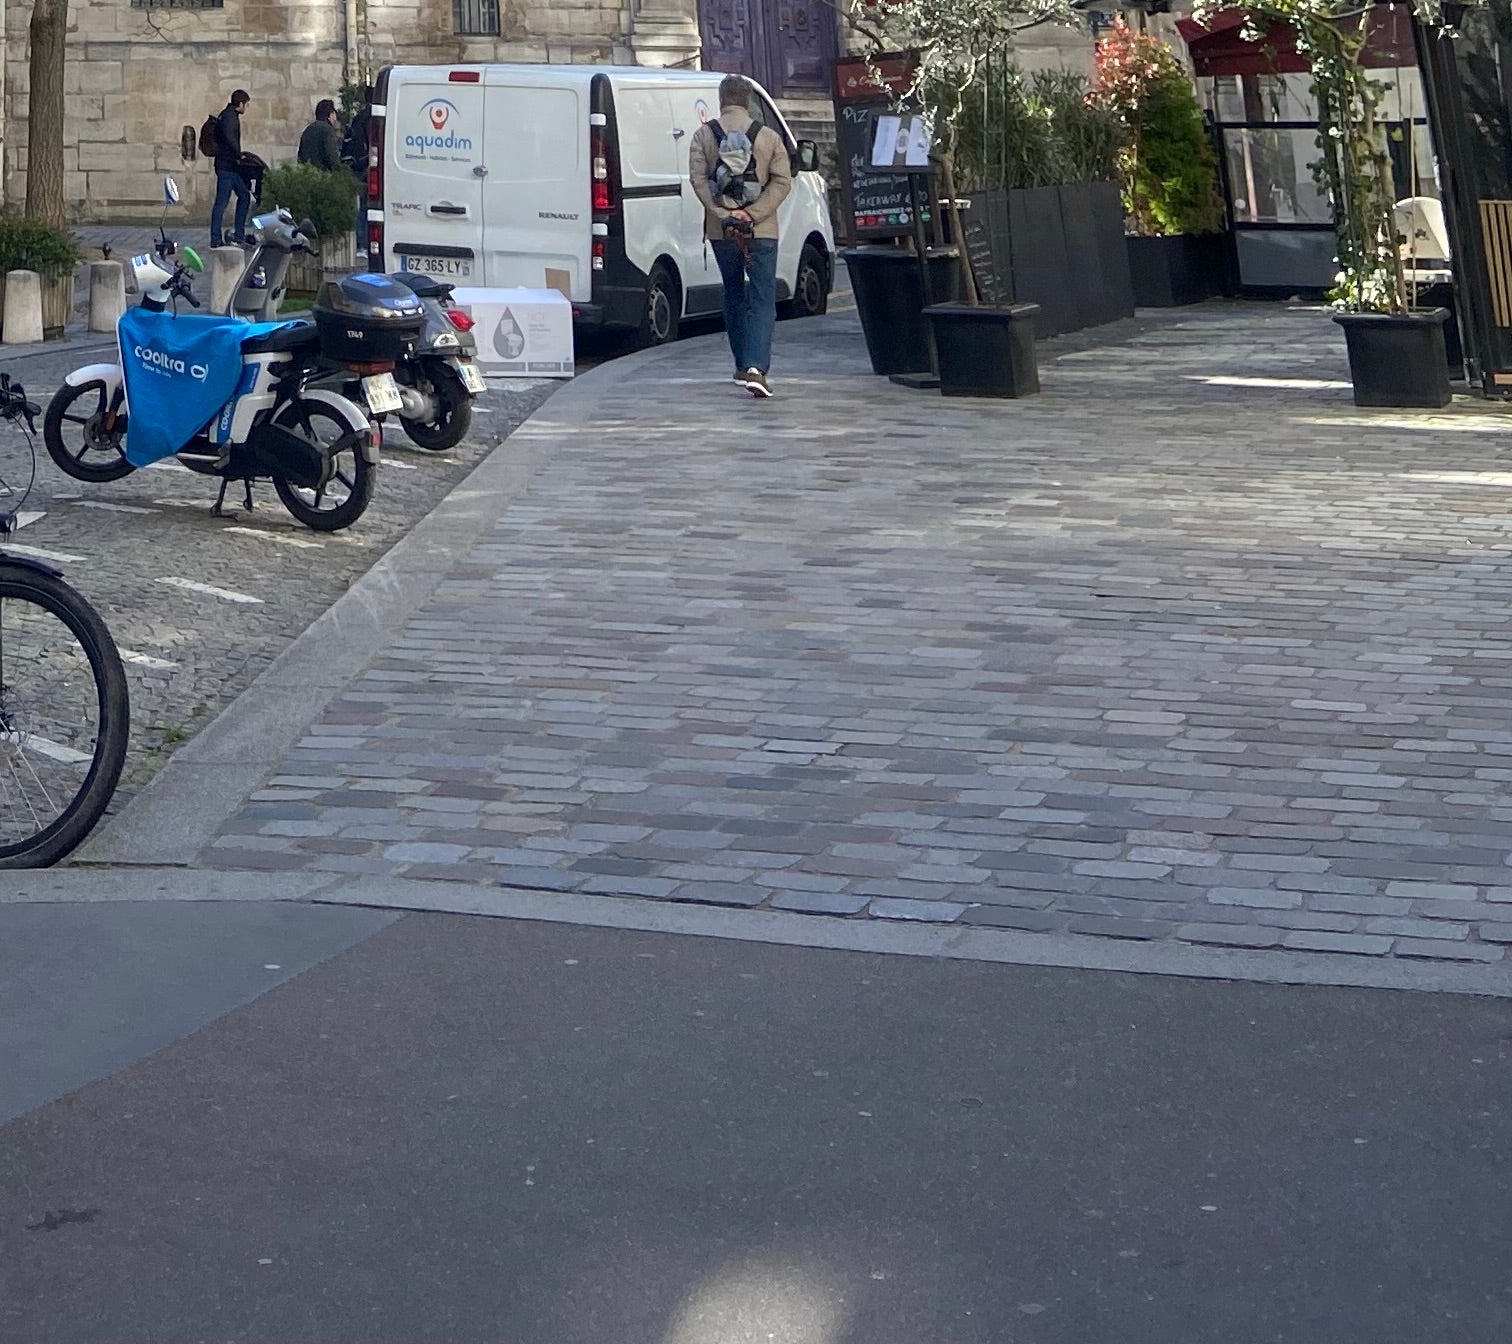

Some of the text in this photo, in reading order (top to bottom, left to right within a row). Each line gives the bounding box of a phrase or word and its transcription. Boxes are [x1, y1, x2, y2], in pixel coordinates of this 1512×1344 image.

[405, 129, 472, 154] aquadim
[392, 202, 422, 210] TRAFIC
[538, 212, 579, 221] RENAULT
[134, 345, 185, 374] cooltra
